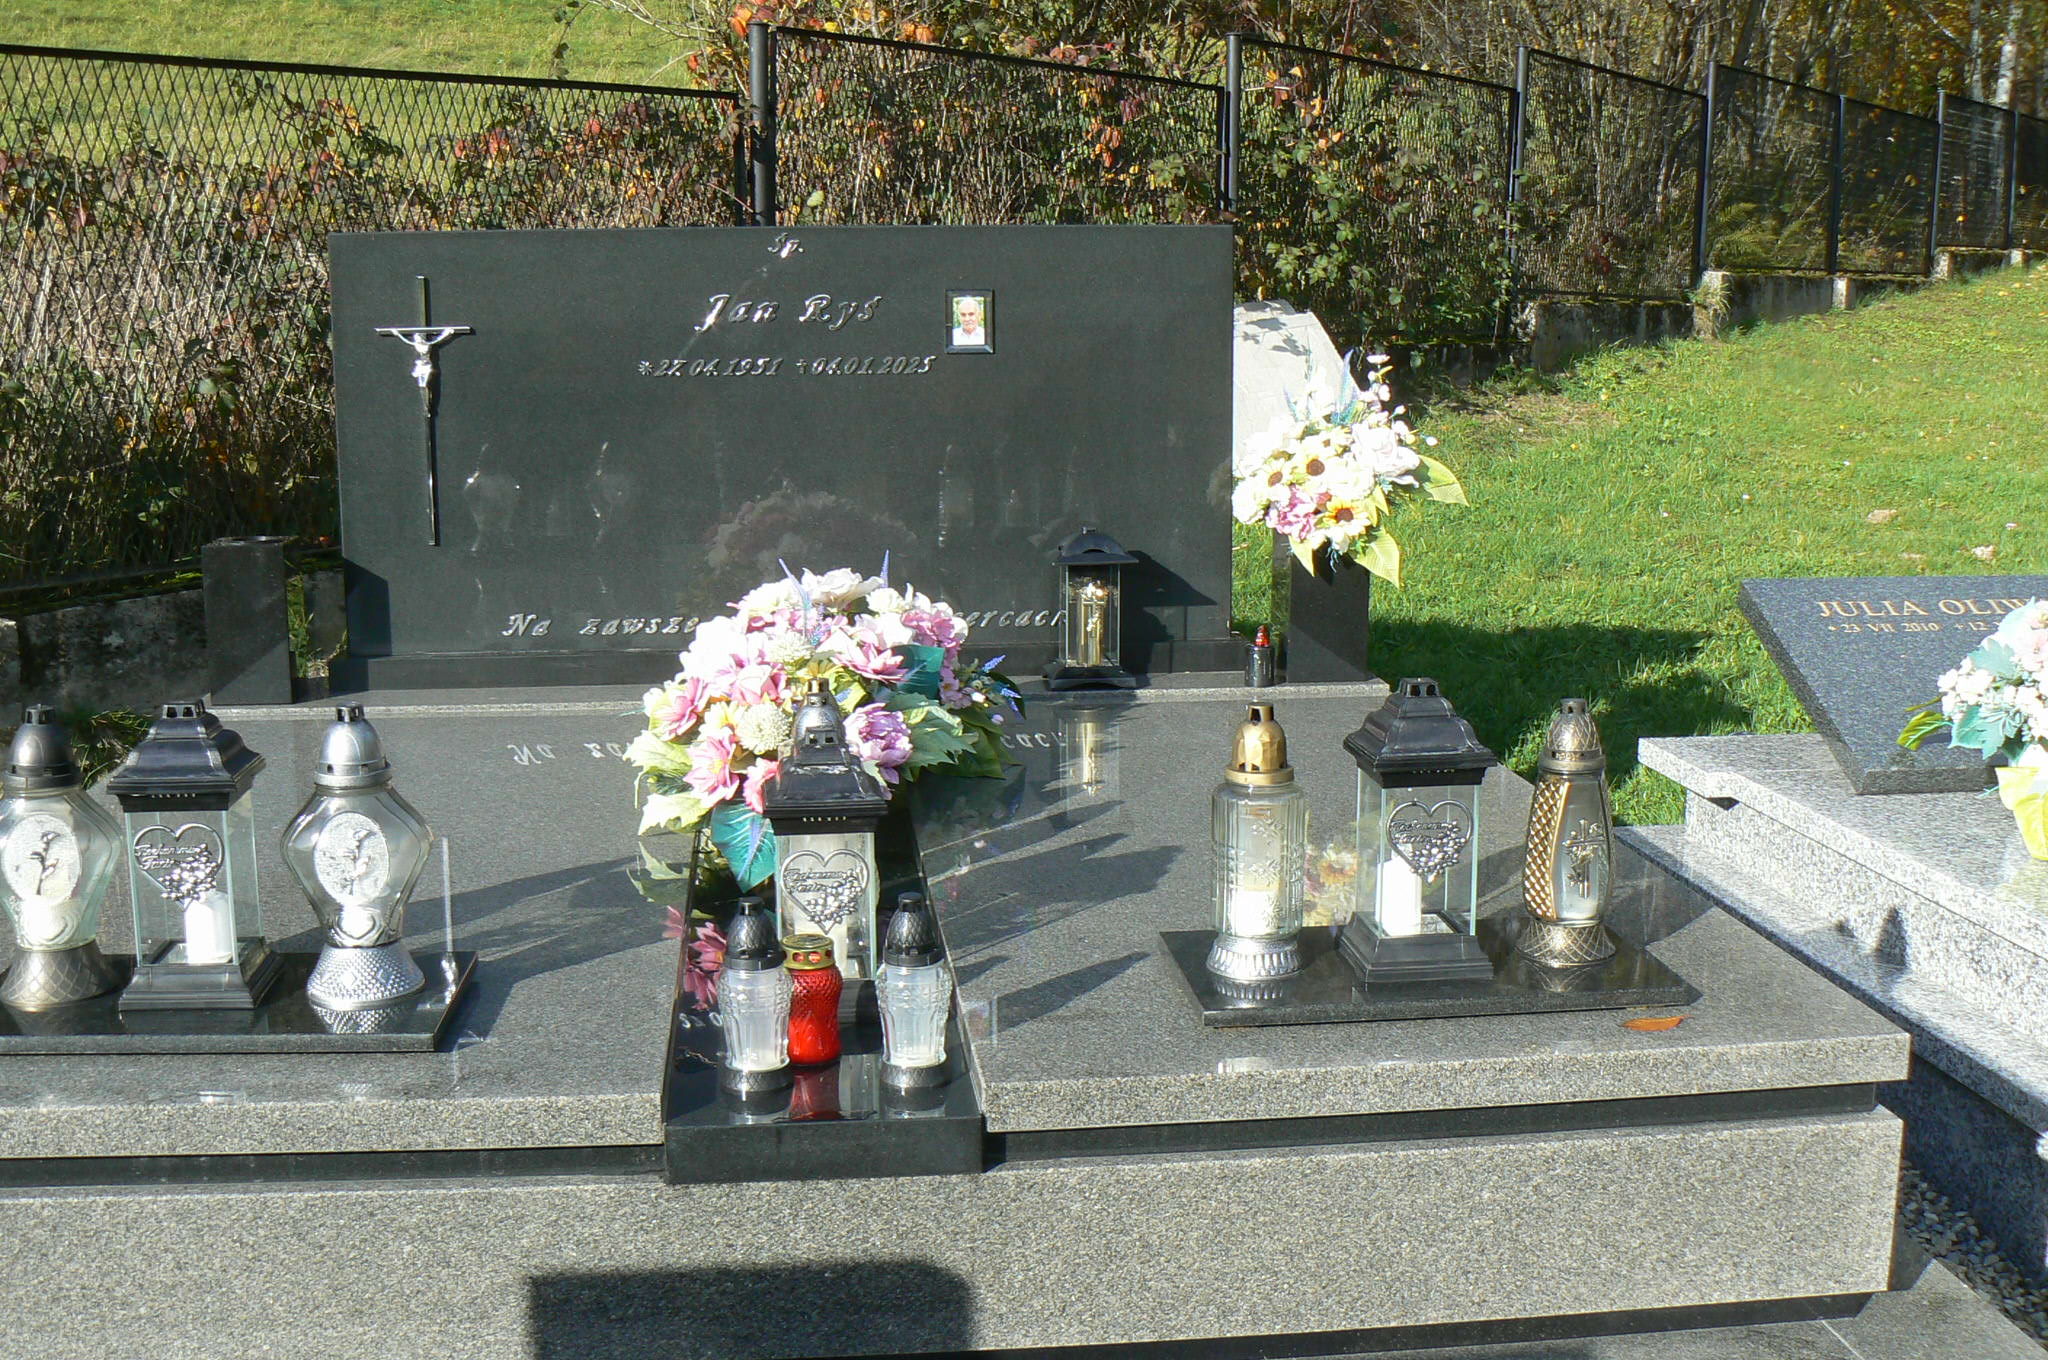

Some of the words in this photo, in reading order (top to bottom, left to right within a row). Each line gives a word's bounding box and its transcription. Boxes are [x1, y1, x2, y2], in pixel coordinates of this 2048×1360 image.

[693, 294, 780, 333] Jan
[1816, 600, 1929, 617] JULIA
[502, 613, 551, 637] Na
[578, 616, 700, 636] zawsze
